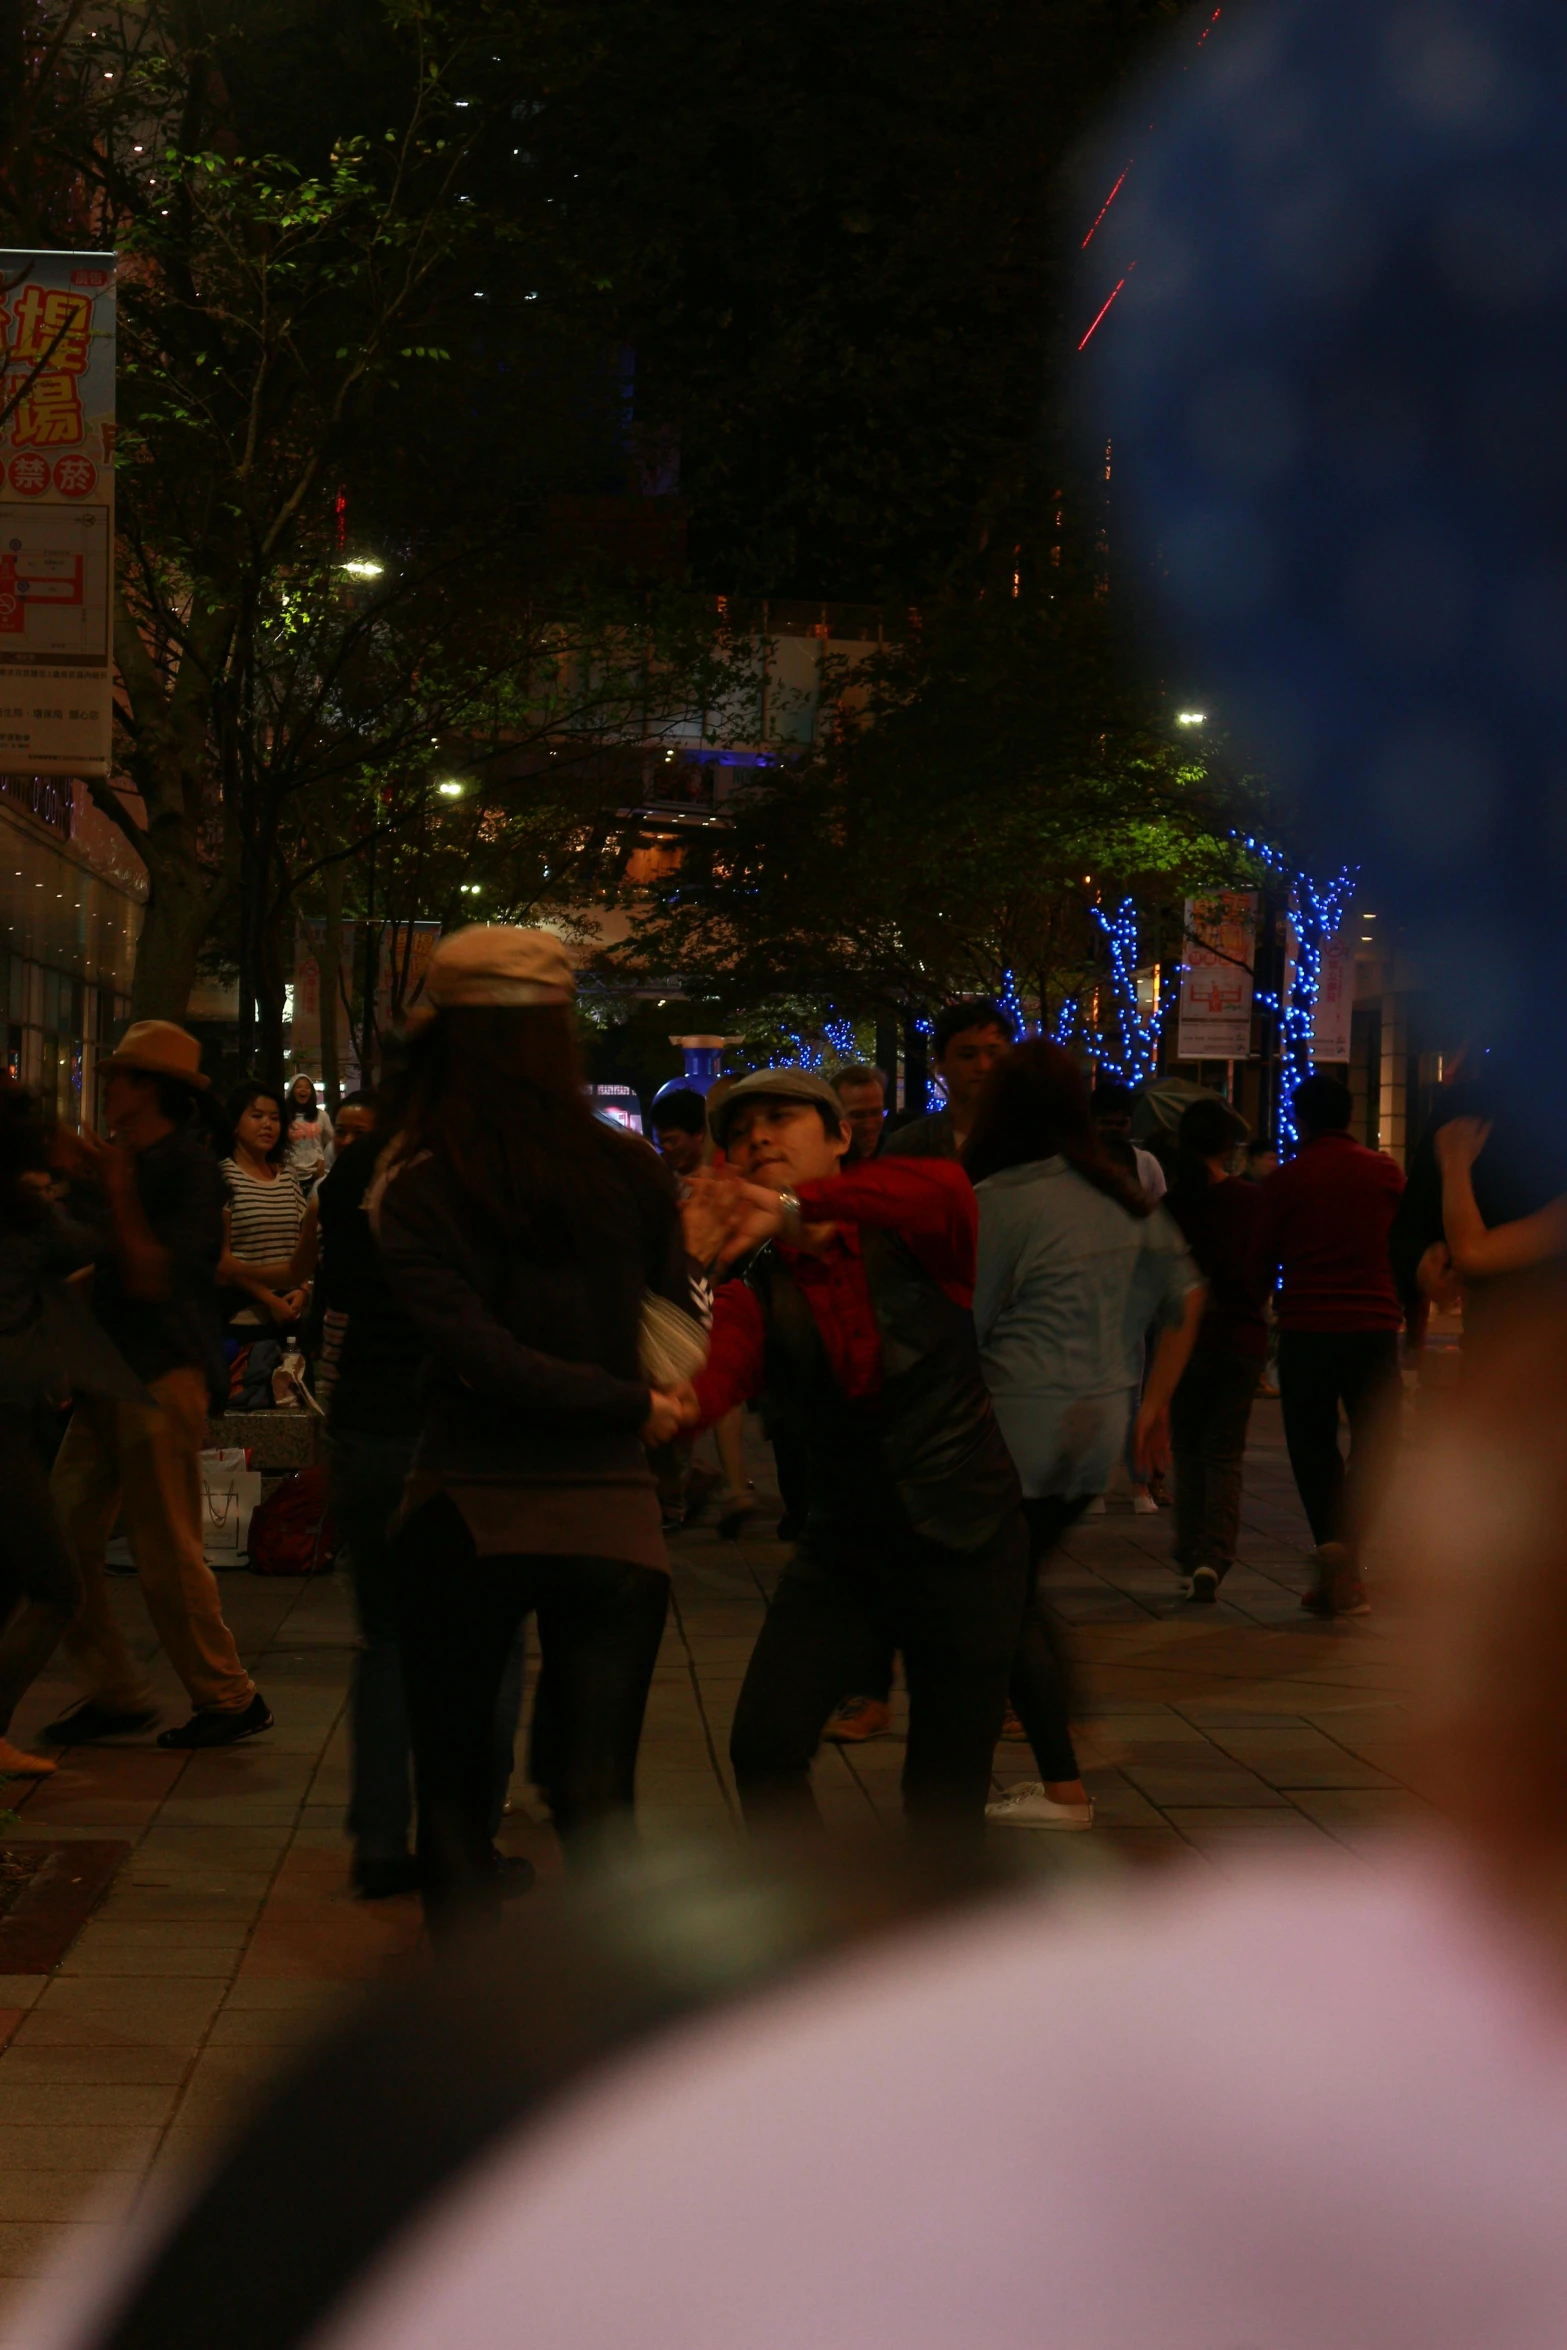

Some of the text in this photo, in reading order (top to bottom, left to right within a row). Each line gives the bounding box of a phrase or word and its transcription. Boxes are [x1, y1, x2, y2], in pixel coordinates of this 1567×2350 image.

[0, 280, 93, 374] 堤
[0, 373, 83, 447] 場
[12, 455, 93, 492] 禁菸
